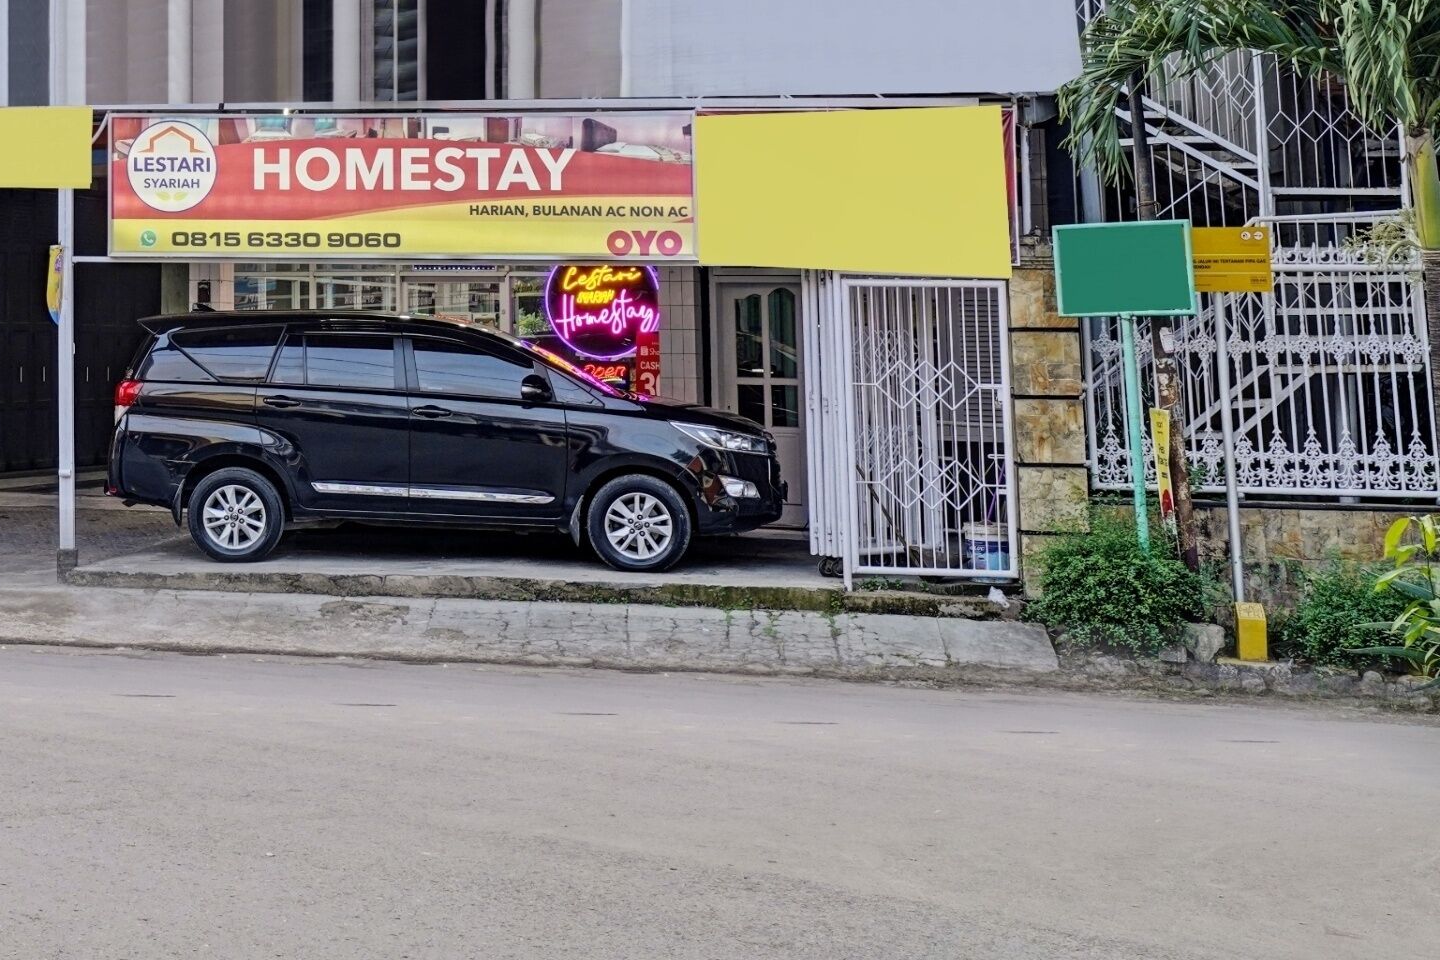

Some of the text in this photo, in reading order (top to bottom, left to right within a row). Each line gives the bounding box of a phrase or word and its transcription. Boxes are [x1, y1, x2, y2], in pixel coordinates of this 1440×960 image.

[133, 157, 211, 173] LESTARI
[253, 147, 577, 191] HOMESTAY
[143, 178, 200, 189] SYARIAH
[469, 205, 688, 218] HARIAN, BULANAN AC NON AC
[171, 231, 401, 248] 0815 6330 9060
[606, 230, 683, 256] OYO
[563, 265, 641, 290] Lestari
[556, 288, 654, 339] Homestay
